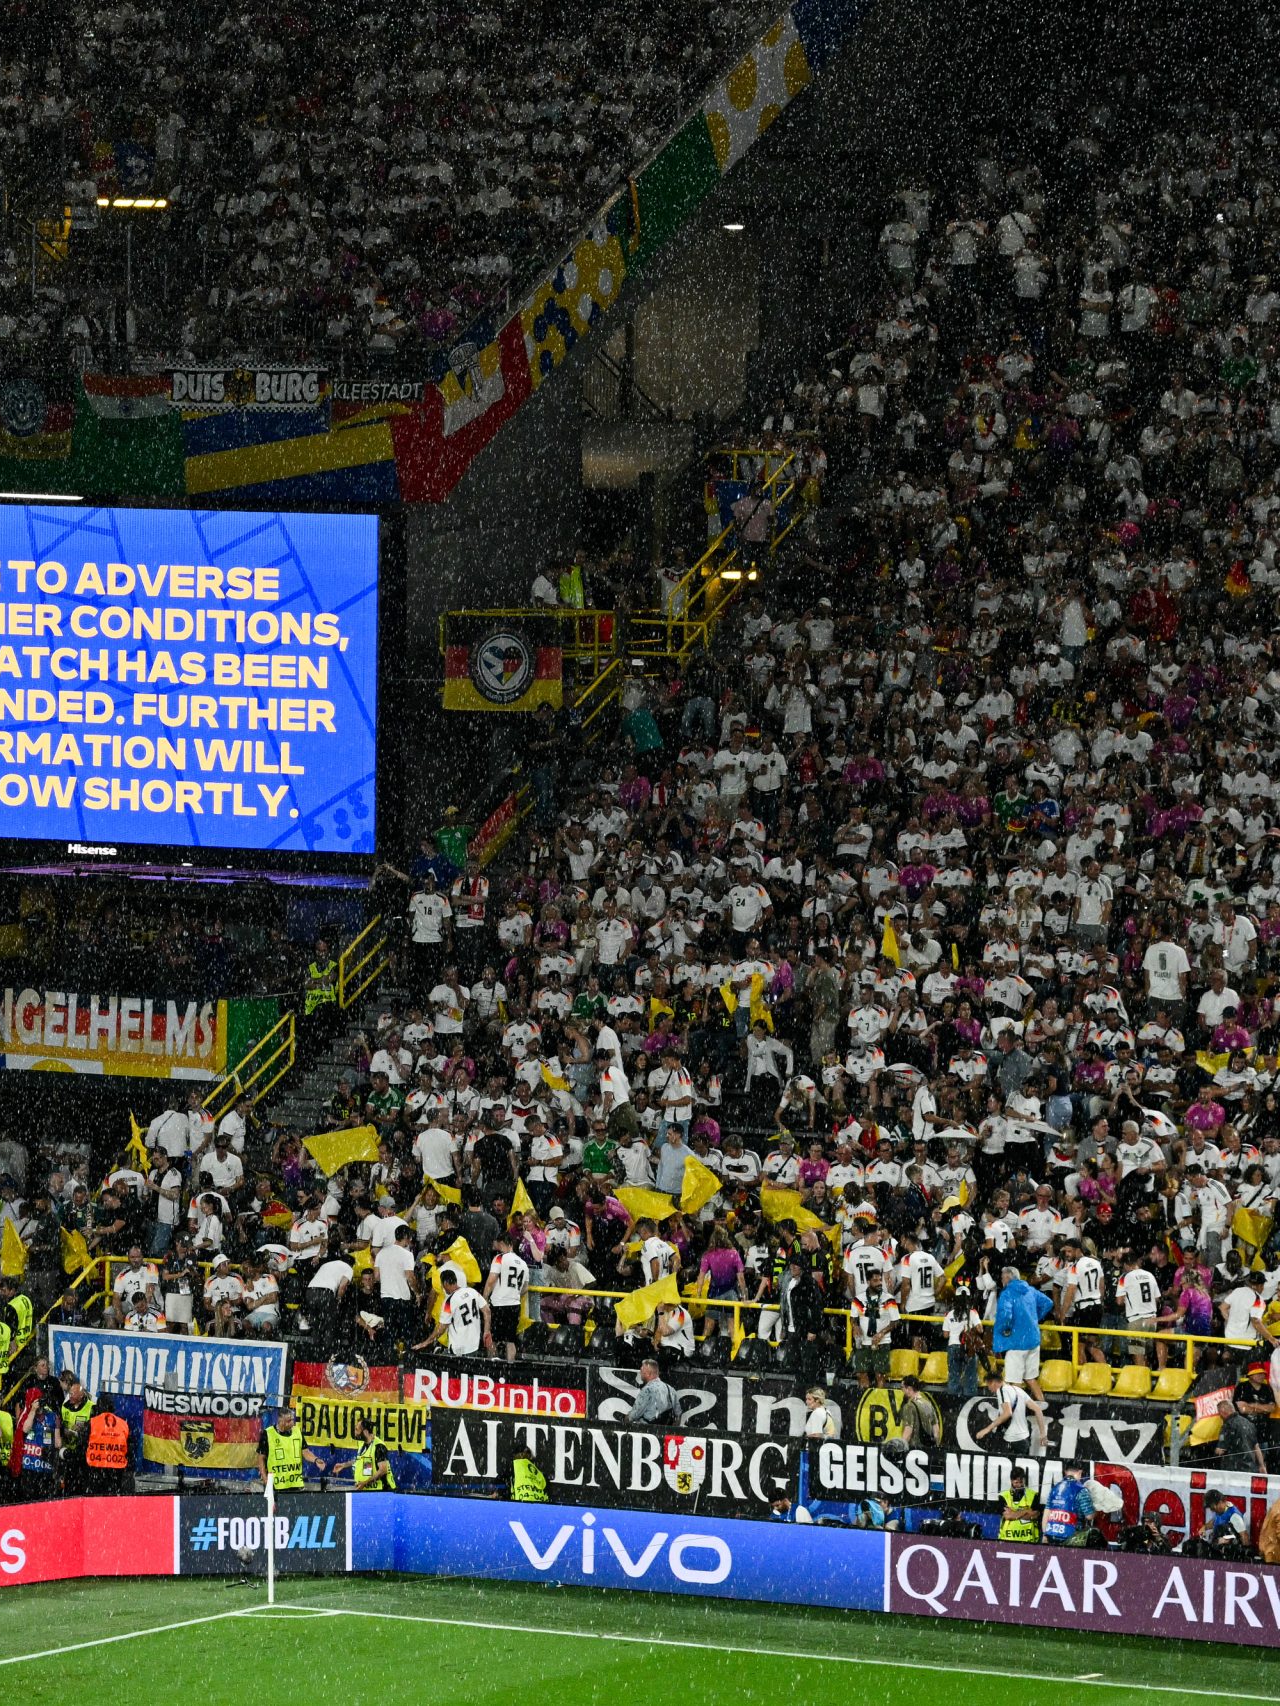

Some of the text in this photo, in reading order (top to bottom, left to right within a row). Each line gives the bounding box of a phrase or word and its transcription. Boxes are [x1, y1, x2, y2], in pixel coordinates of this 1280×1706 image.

[332, 381, 423, 402] KLEESTADT
[7, 560, 68, 594] TO
[73, 562, 280, 601] ADVERSE
[70, 605, 350, 652] CONDITIONS,
[117, 649, 207, 685] HAS
[213, 653, 328, 689] BEEN
[133, 693, 337, 733] FURTHER
[193, 738, 305, 775] WILL
[83, 776, 299, 819] SHORTLY.
[67, 842, 118, 856] Hisense
[508, 1266, 525, 1289] 24
[1084, 1268, 1099, 1293] 17
[1139, 1281, 1152, 1304] 8
[459, 1298, 479, 1327] 24
[60, 1341, 272, 1402] NORDHAUSEN
[145, 1386, 264, 1416] WIESMOOR
[412, 1368, 577, 1417] RUBinho
[190, 1514, 338, 1552] #FOOTBALL
[508, 1512, 732, 1585] vivo
[896, 1543, 1122, 1617] QATAR
